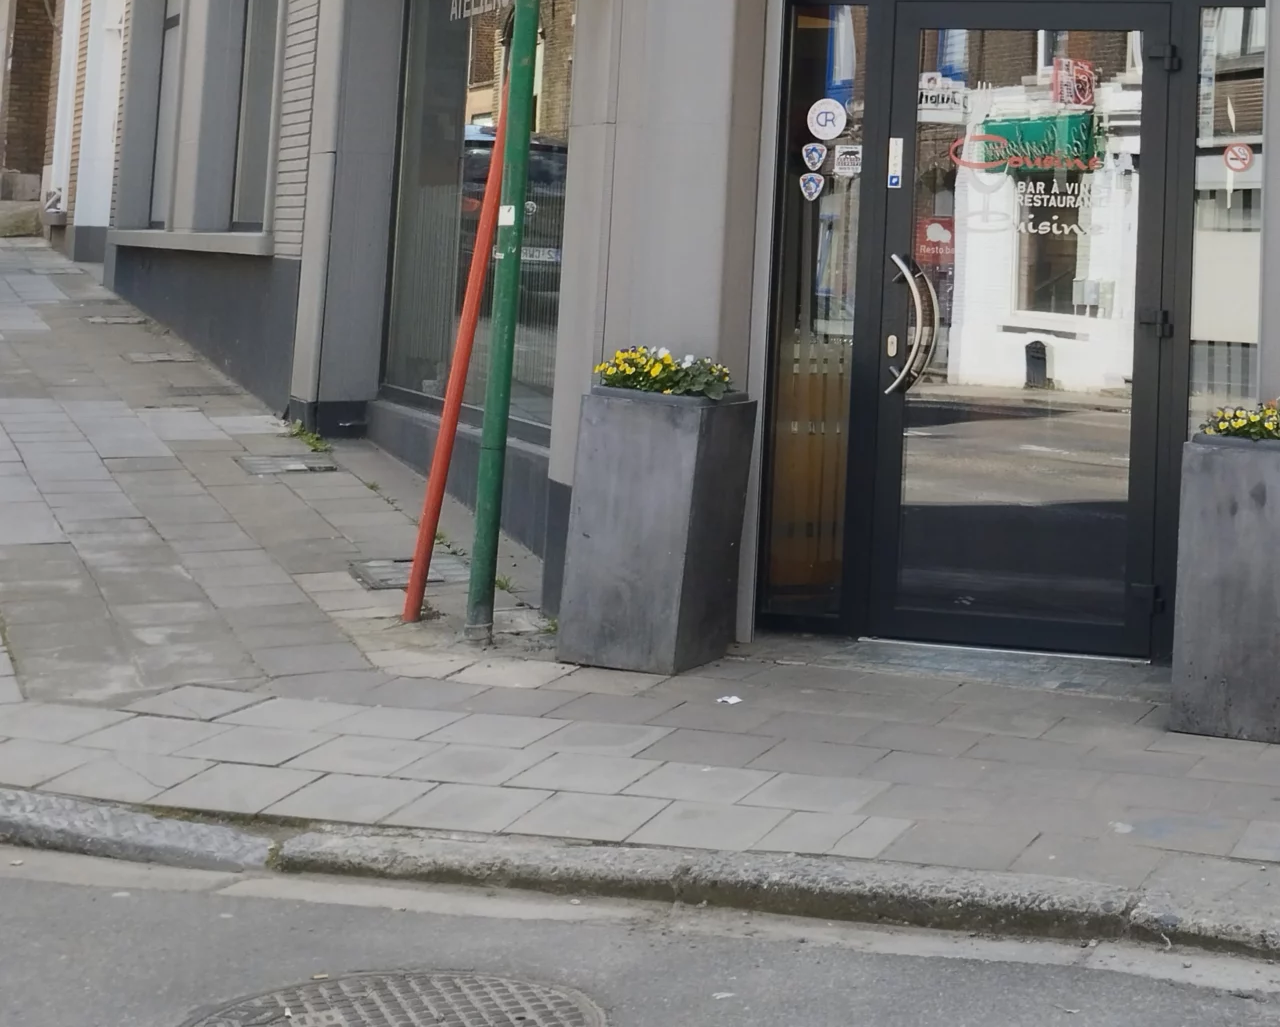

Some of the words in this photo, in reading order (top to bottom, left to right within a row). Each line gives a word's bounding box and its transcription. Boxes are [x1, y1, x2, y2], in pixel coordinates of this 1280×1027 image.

[949, 134, 1105, 171] Cousins
[1017, 181, 1045, 194] BAR
[1050, 178, 1060, 194] À
[1016, 195, 1096, 208] RESTAURAN
